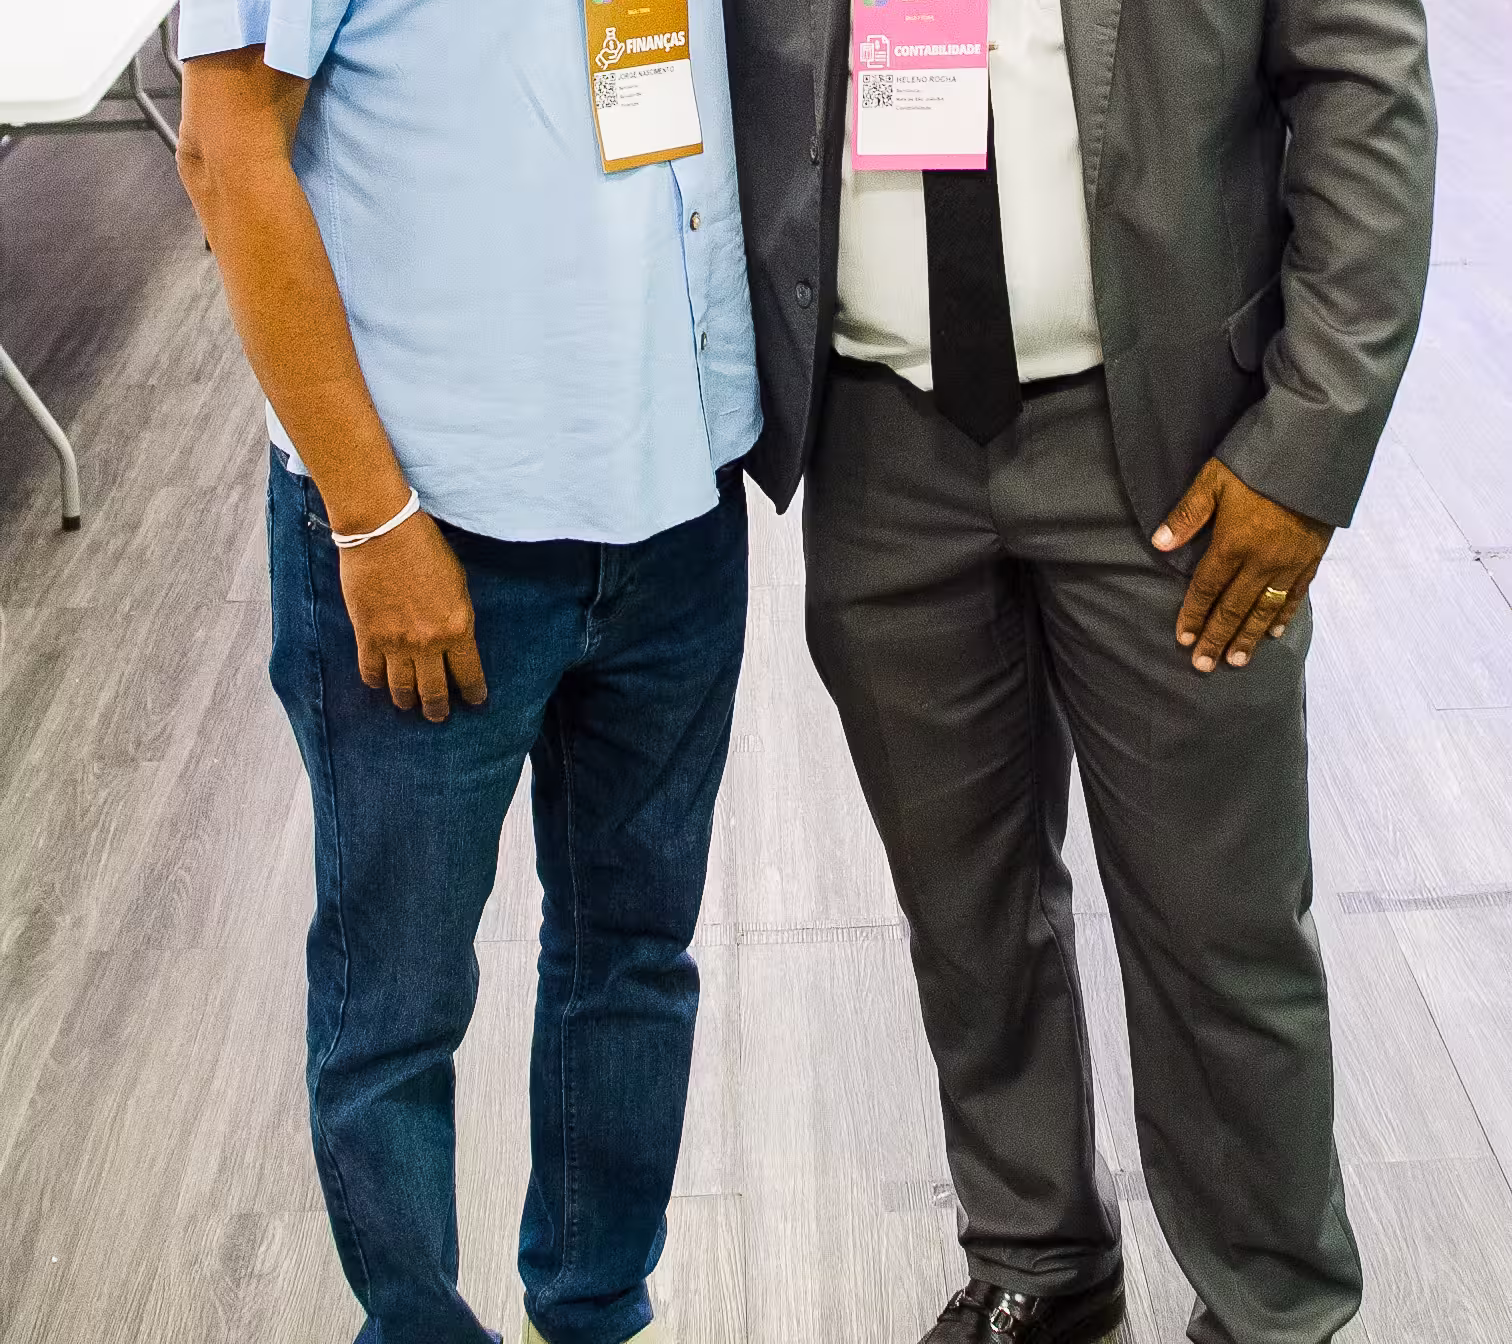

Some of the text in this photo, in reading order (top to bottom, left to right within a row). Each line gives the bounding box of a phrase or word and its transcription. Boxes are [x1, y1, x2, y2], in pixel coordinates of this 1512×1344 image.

[626, 31, 685, 53] FINANÇAS
[894, 44, 981, 57] CONTABILIDADE
[896, 75, 957, 83] HELENO ROCHA
